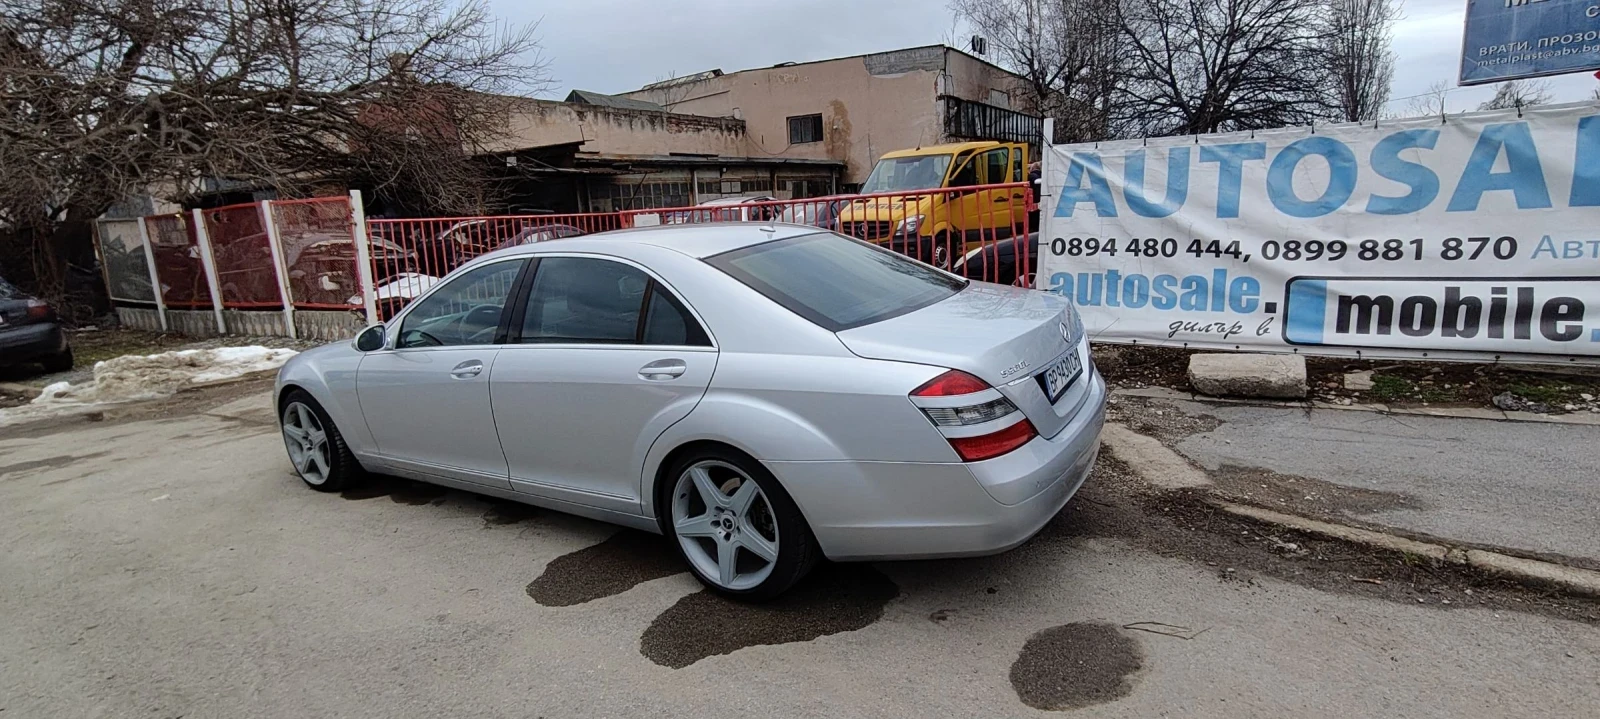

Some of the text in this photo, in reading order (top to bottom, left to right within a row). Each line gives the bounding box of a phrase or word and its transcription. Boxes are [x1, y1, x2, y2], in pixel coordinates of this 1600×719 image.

[1477, 44, 1600, 67] metalplast@abv.bg
[1479, 30, 1600, 57] ВРАТИ, ПРОЗО
[1051, 238, 1118, 256] 0894
[1125, 238, 1178, 257] 480
[1186, 238, 1252, 262] 444,
[1261, 240, 1348, 261] 0899
[1357, 238, 1424, 261] 881
[1440, 236, 1518, 261] 870
[1050, 268, 1277, 314] autosale.
